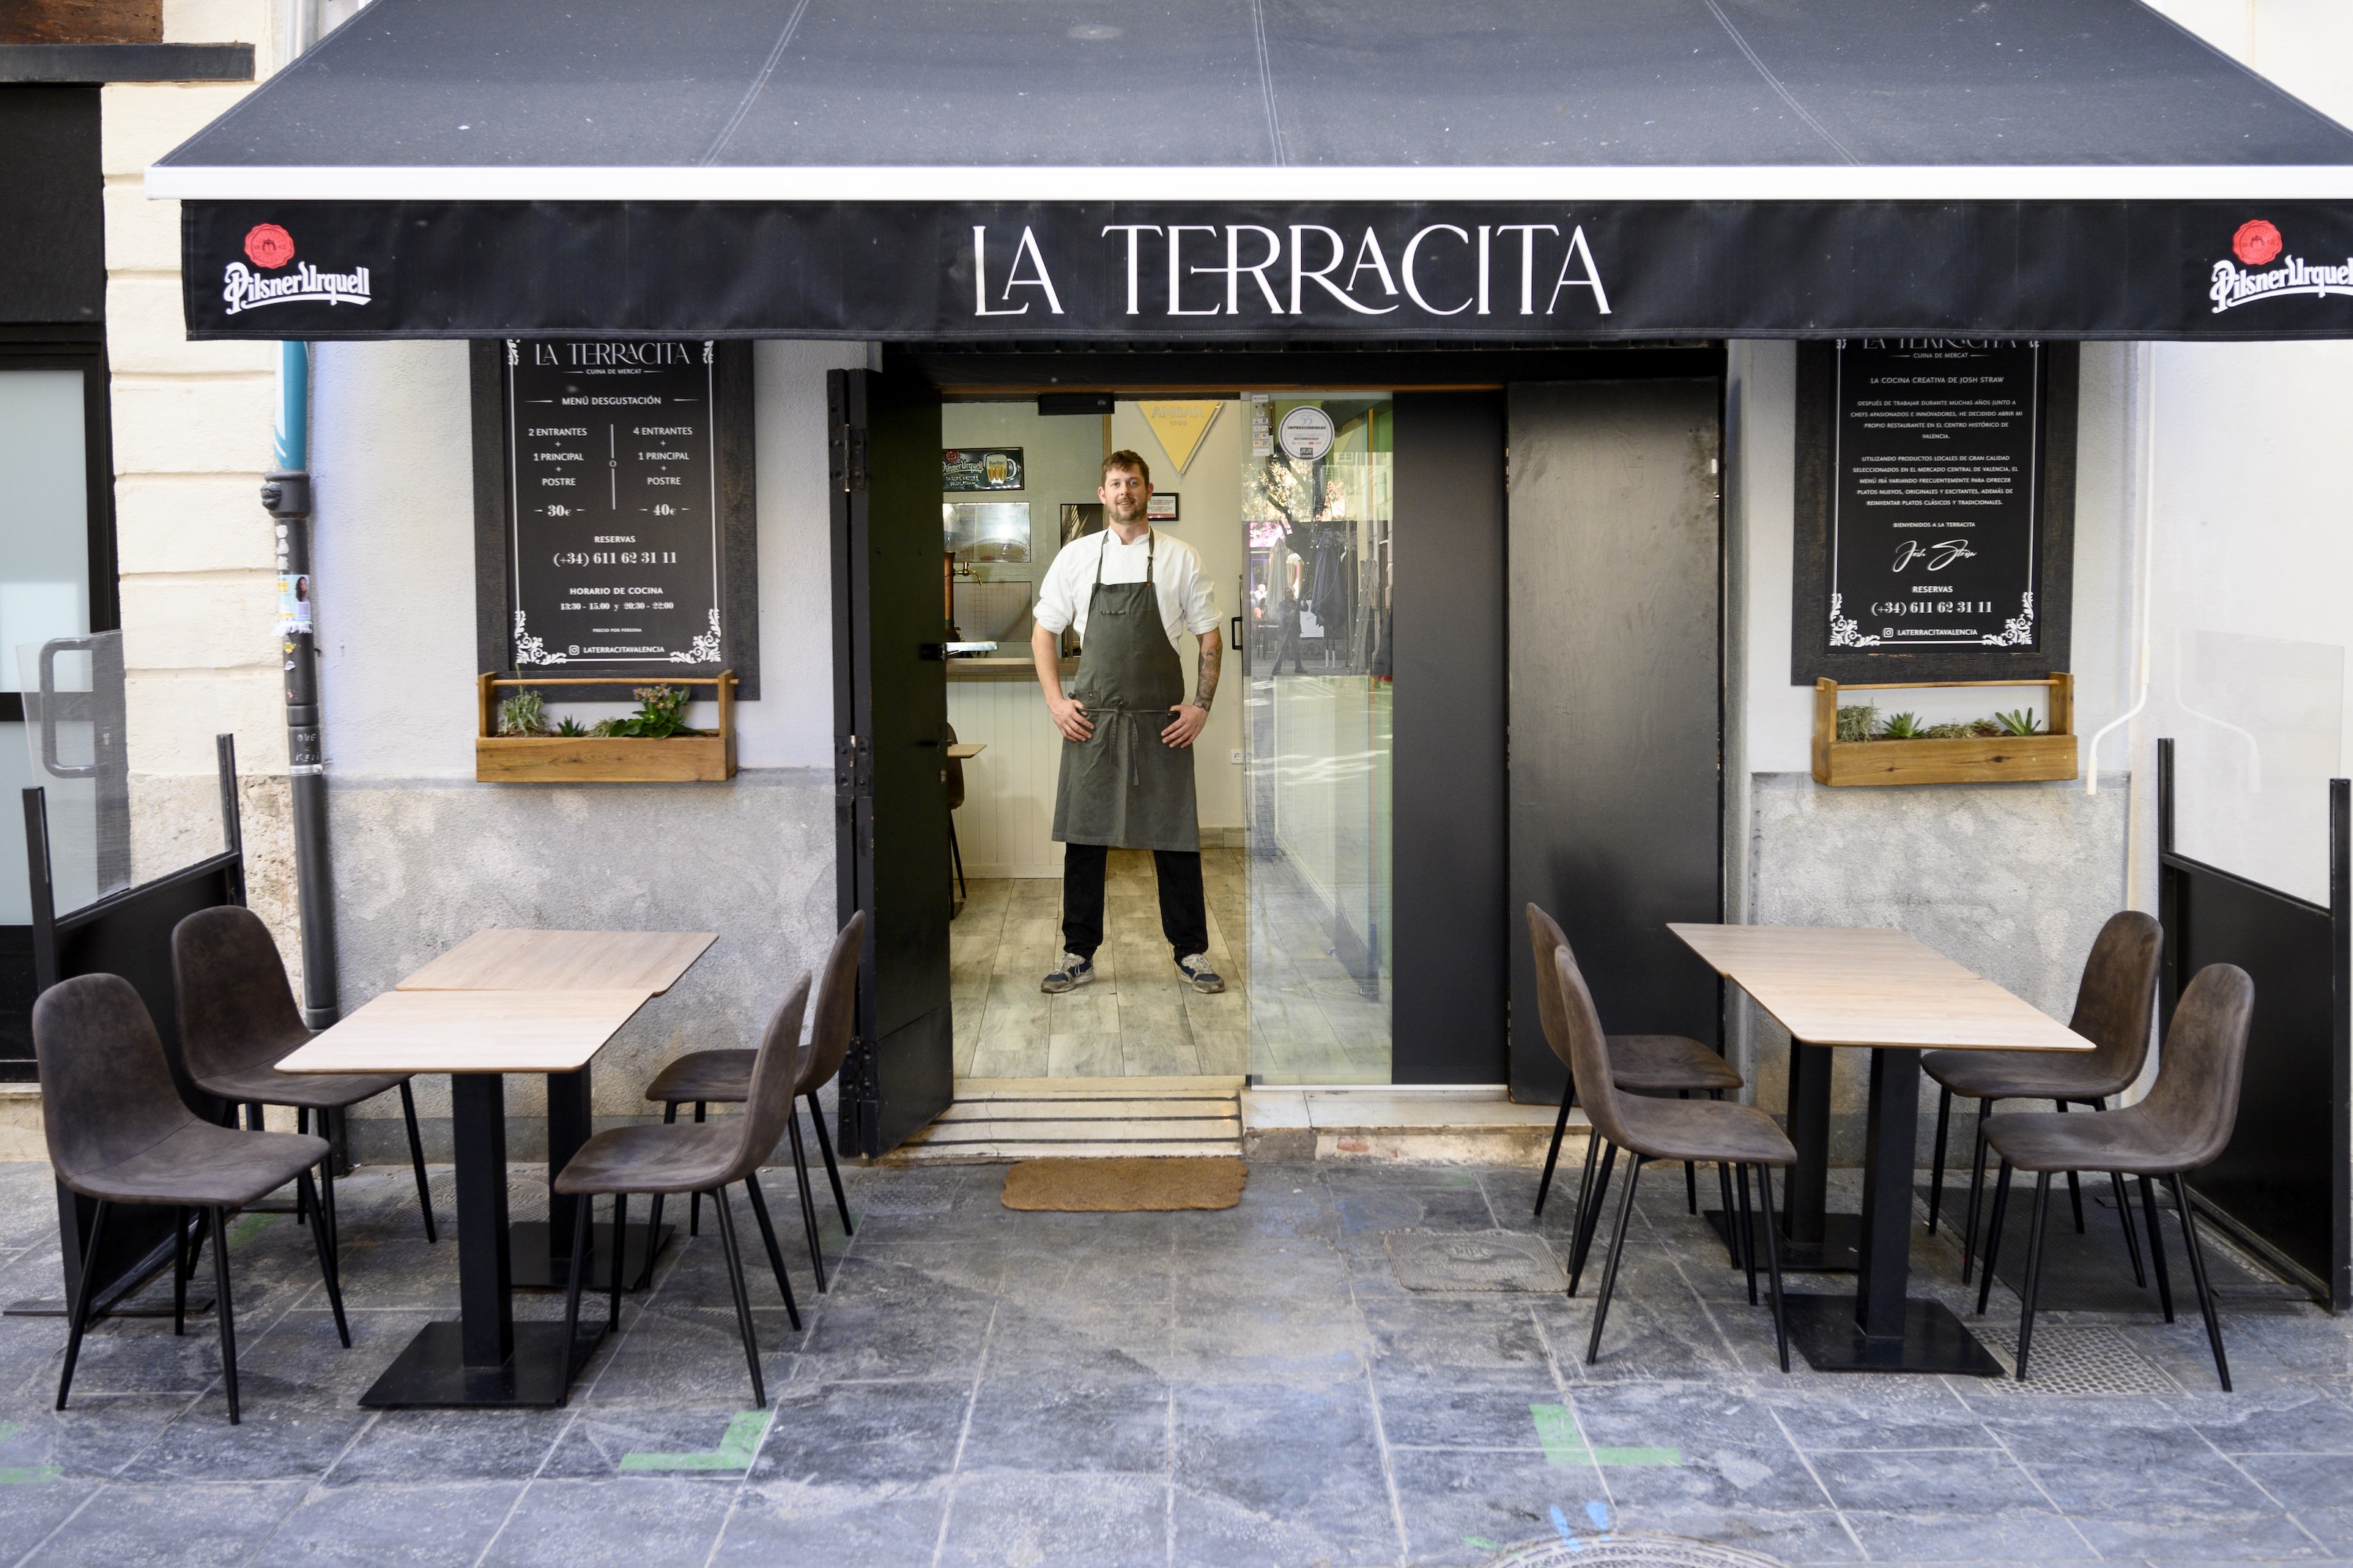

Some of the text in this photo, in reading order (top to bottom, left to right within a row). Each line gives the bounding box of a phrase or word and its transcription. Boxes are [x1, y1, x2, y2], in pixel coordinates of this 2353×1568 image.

[973, 223, 1612, 316] LA TERRACITA
[223, 261, 371, 315] Pilsner Urquell
[2209, 254, 2353, 314] Pilsner Urquel
[536, 342, 691, 365] LA TERRACITA
[1959, 376, 1978, 384] JOSH
[591, 395, 662, 405] DESGUSTACIÓN
[1152, 406, 1204, 418] AMBAR
[1300, 414, 1313, 426] 55
[528, 428, 588, 436] 2 ENTRANTES
[633, 426, 693, 436] 4 ENTRANTES
[533, 453, 585, 461] 1 PRINCIPAL
[638, 452, 690, 461] 1 PRINCIPAL
[960, 459, 984, 474] Urquell
[542, 478, 577, 486] POSTRE
[647, 477, 681, 486] POSTRE
[547, 504, 571, 517] 30€
[653, 503, 677, 516] 40€
[594, 535, 636, 543] RESERVAS
[553, 551, 677, 568] (+34) 611 62 31 11
[569, 587, 664, 595] HORARIO DE COCINA
[1912, 585, 1954, 593] RESERVAS
[1871, 601, 1992, 617] (+34) 611 62 31 11
[1897, 628, 1978, 636] LATERRACITAVALENCIA
[583, 646, 665, 654] LATERRACITAVALENCIA
